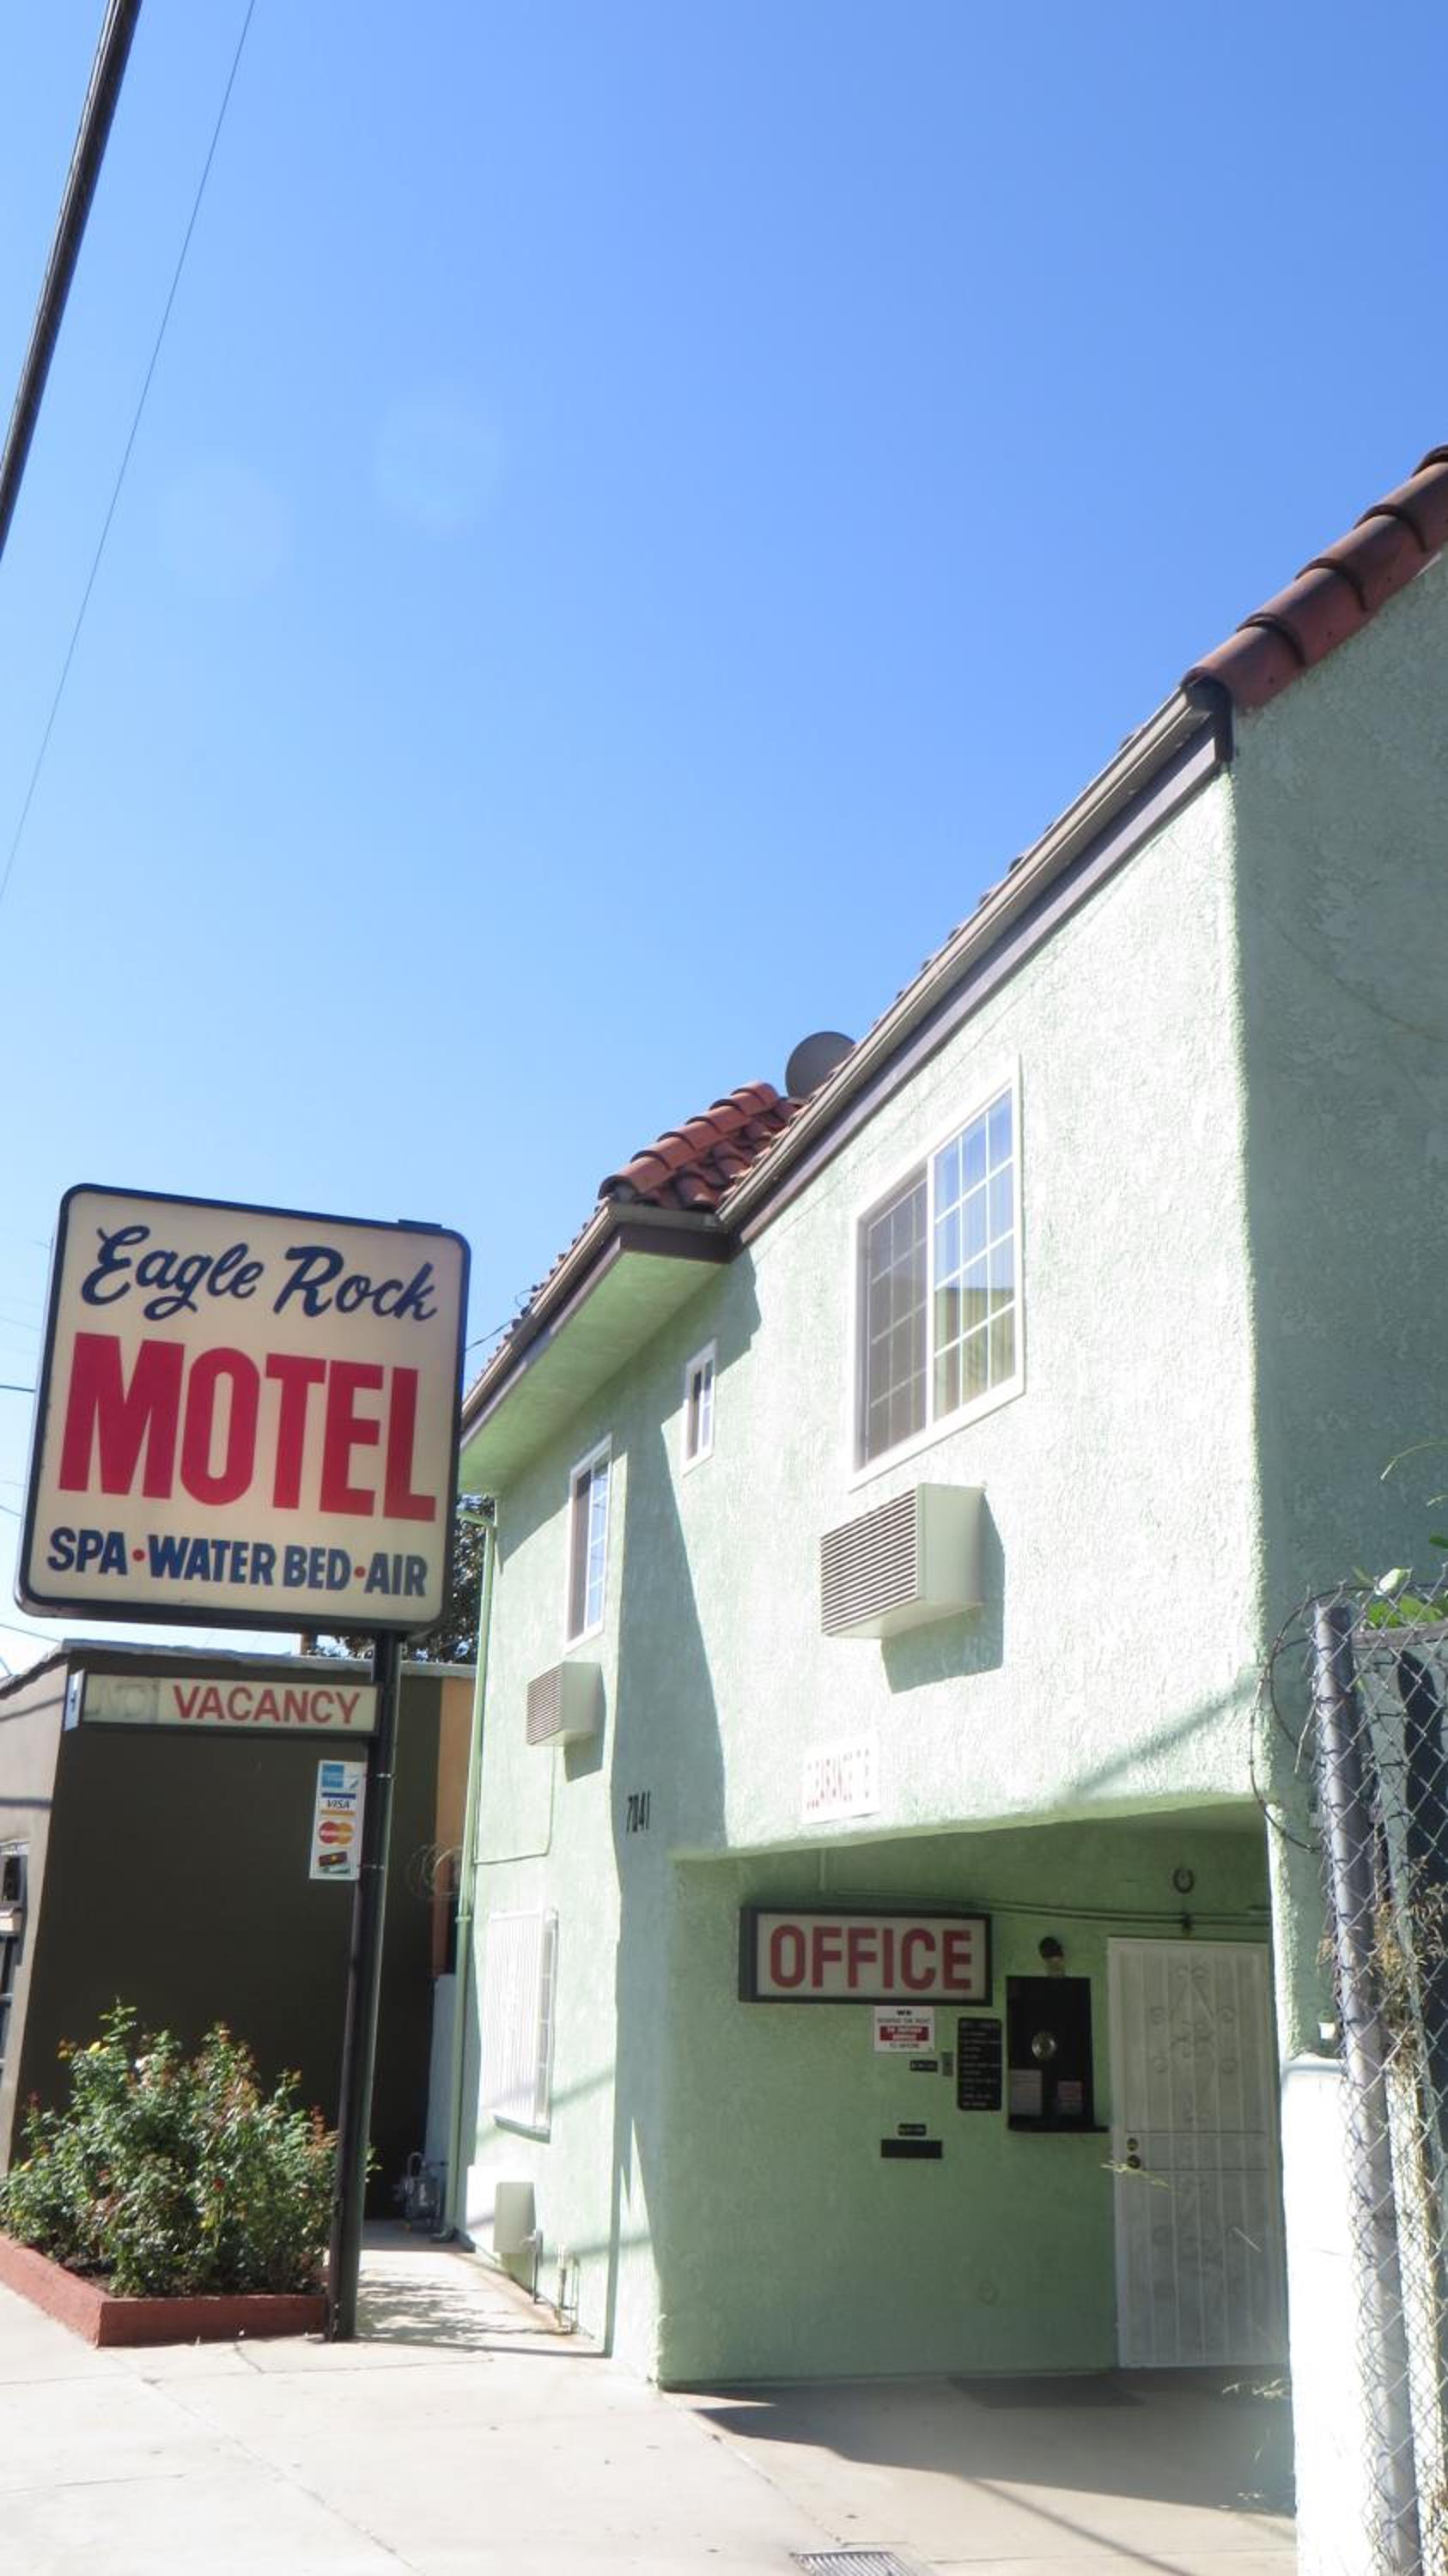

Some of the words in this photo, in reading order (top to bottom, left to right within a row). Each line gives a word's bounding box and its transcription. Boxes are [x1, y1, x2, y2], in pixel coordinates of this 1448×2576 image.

[81, 1224, 265, 1321] Eagle
[273, 1245, 438, 1322] Rock
[58, 1332, 436, 1522] MOTEL
[283, 1545, 352, 1592] BED
[173, 1684, 362, 1725] VACANCY
[325, 1798, 351, 1810] VISA
[769, 1924, 973, 1991] OFFICE
